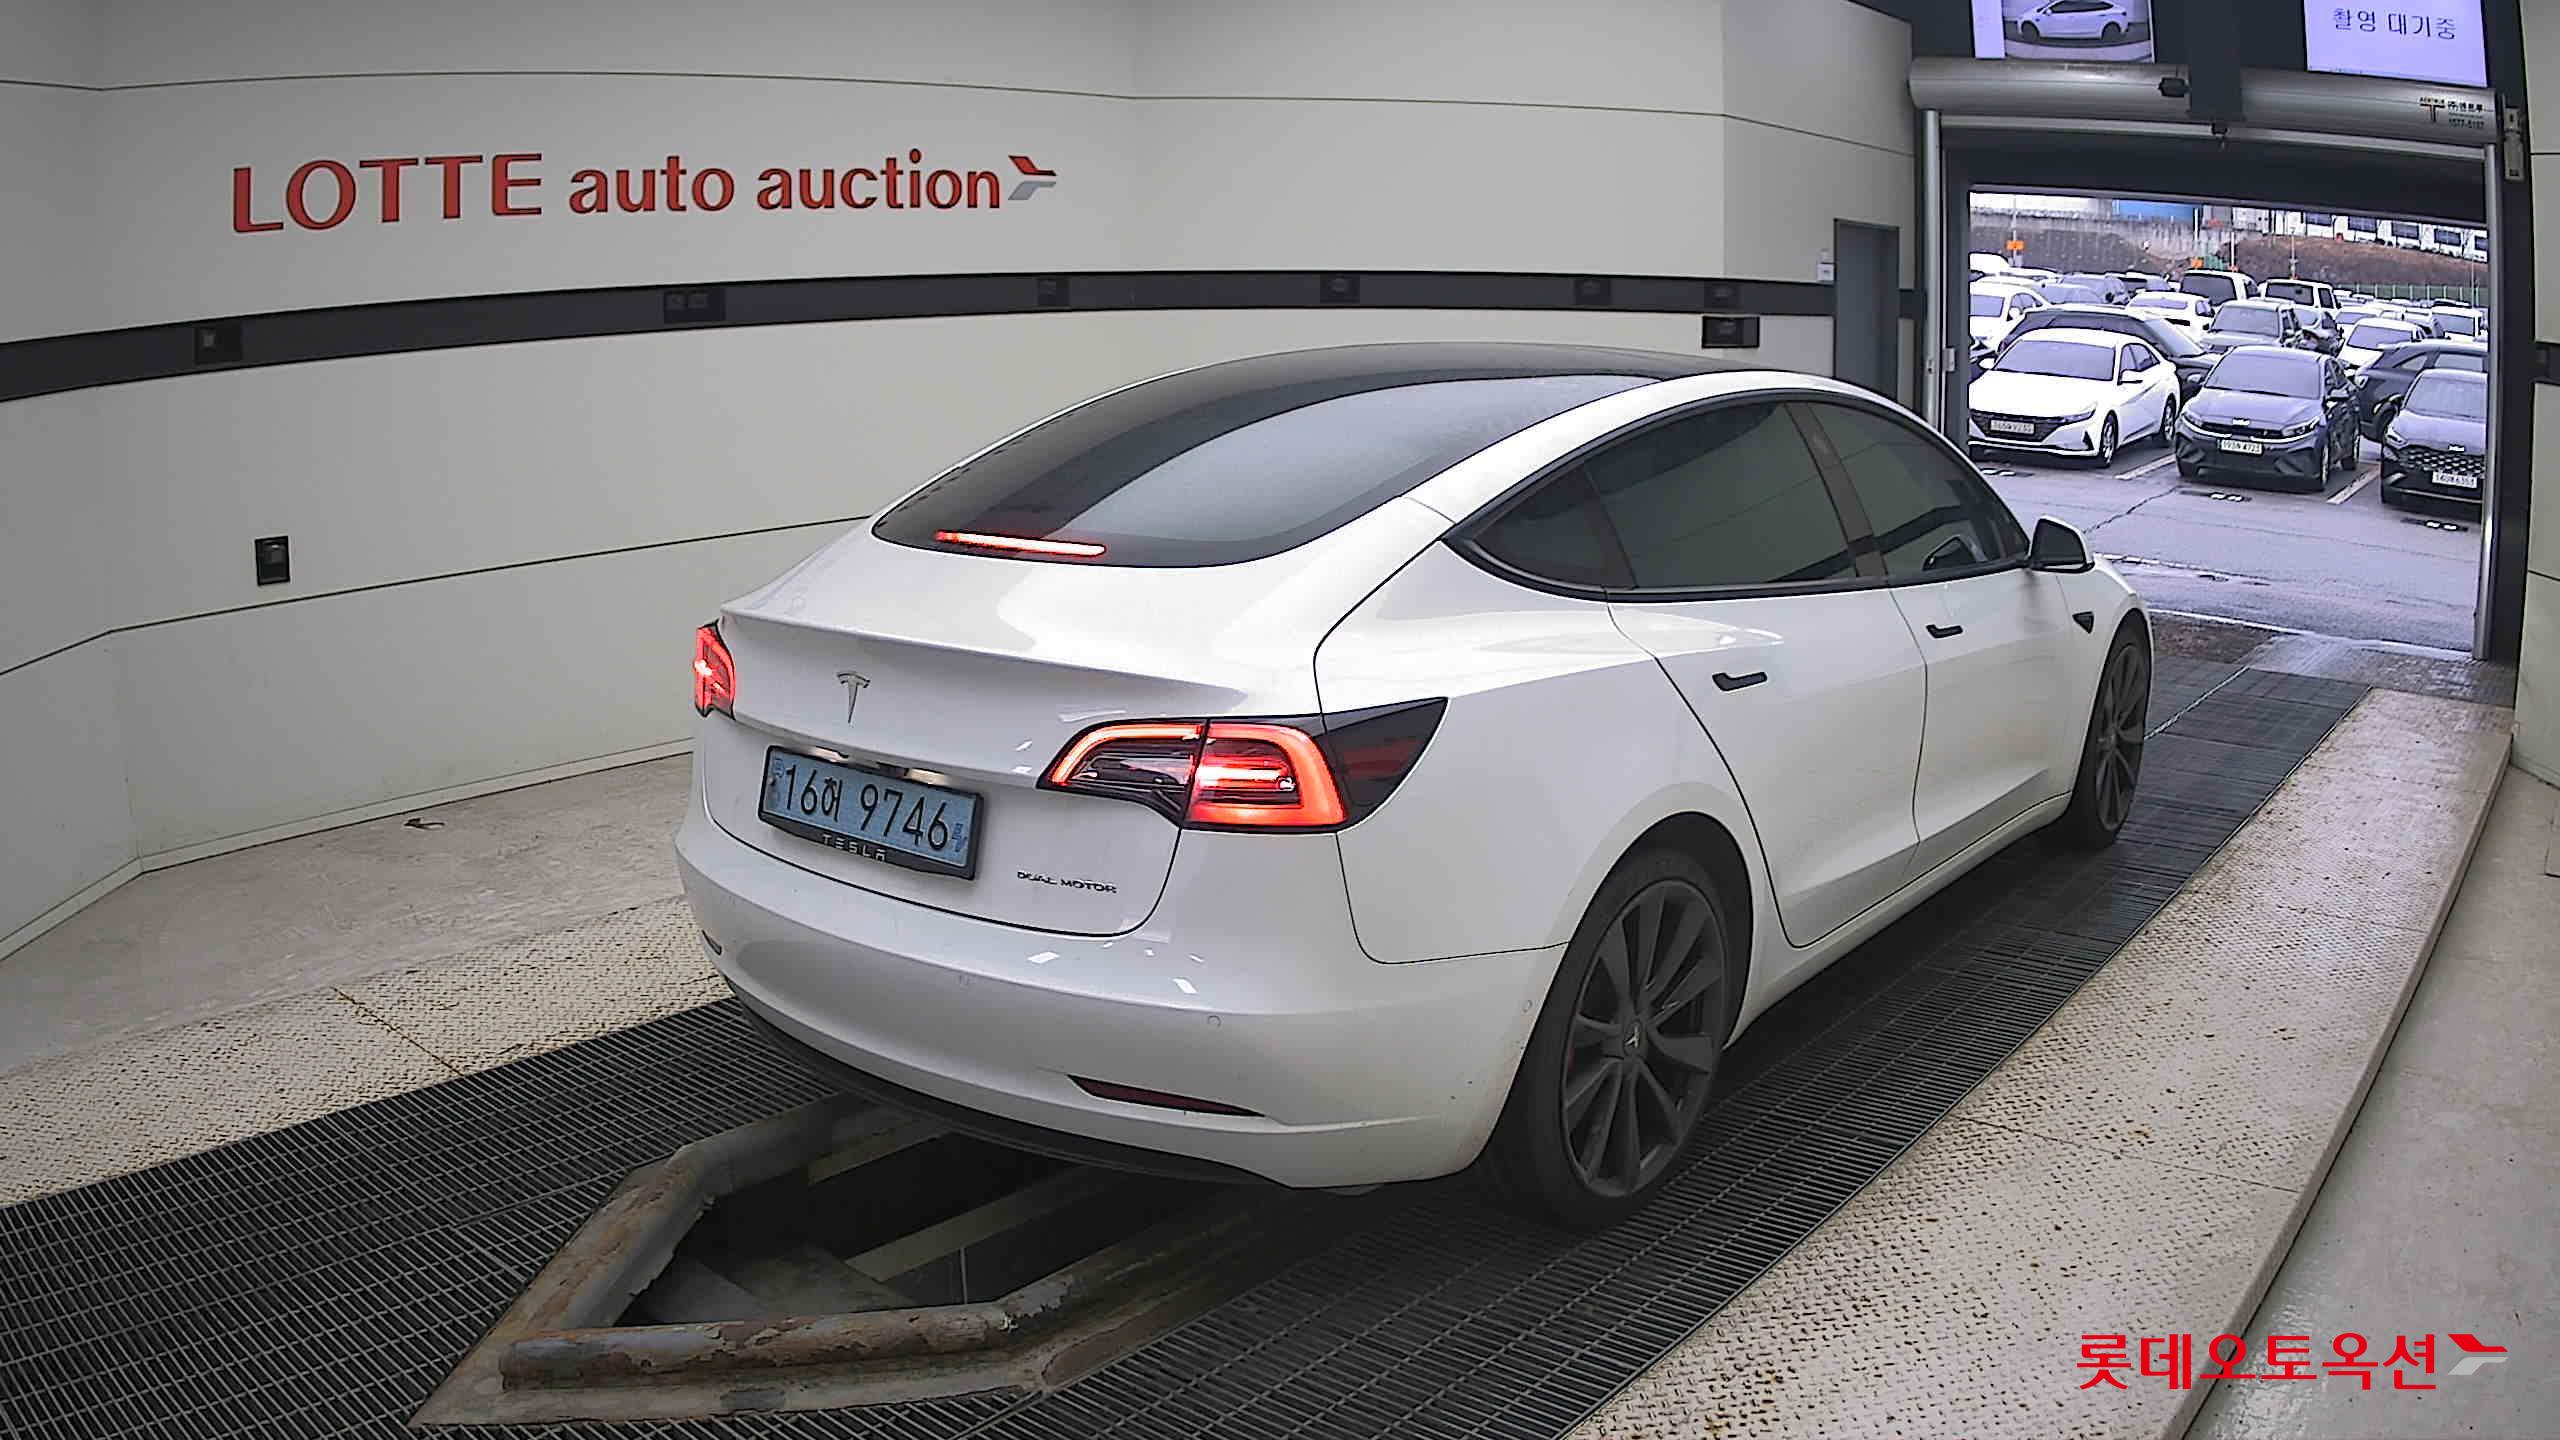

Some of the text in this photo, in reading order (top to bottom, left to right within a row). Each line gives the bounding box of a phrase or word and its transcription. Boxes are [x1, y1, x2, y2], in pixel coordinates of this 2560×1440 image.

[2388, 13, 2457, 40] 대기중
[234, 149, 1001, 233] LOTTE auto auction
[860, 784, 949, 851] 9746
[821, 833, 888, 862] TESLA
[1017, 871, 1117, 894] DUAL MOTOR
